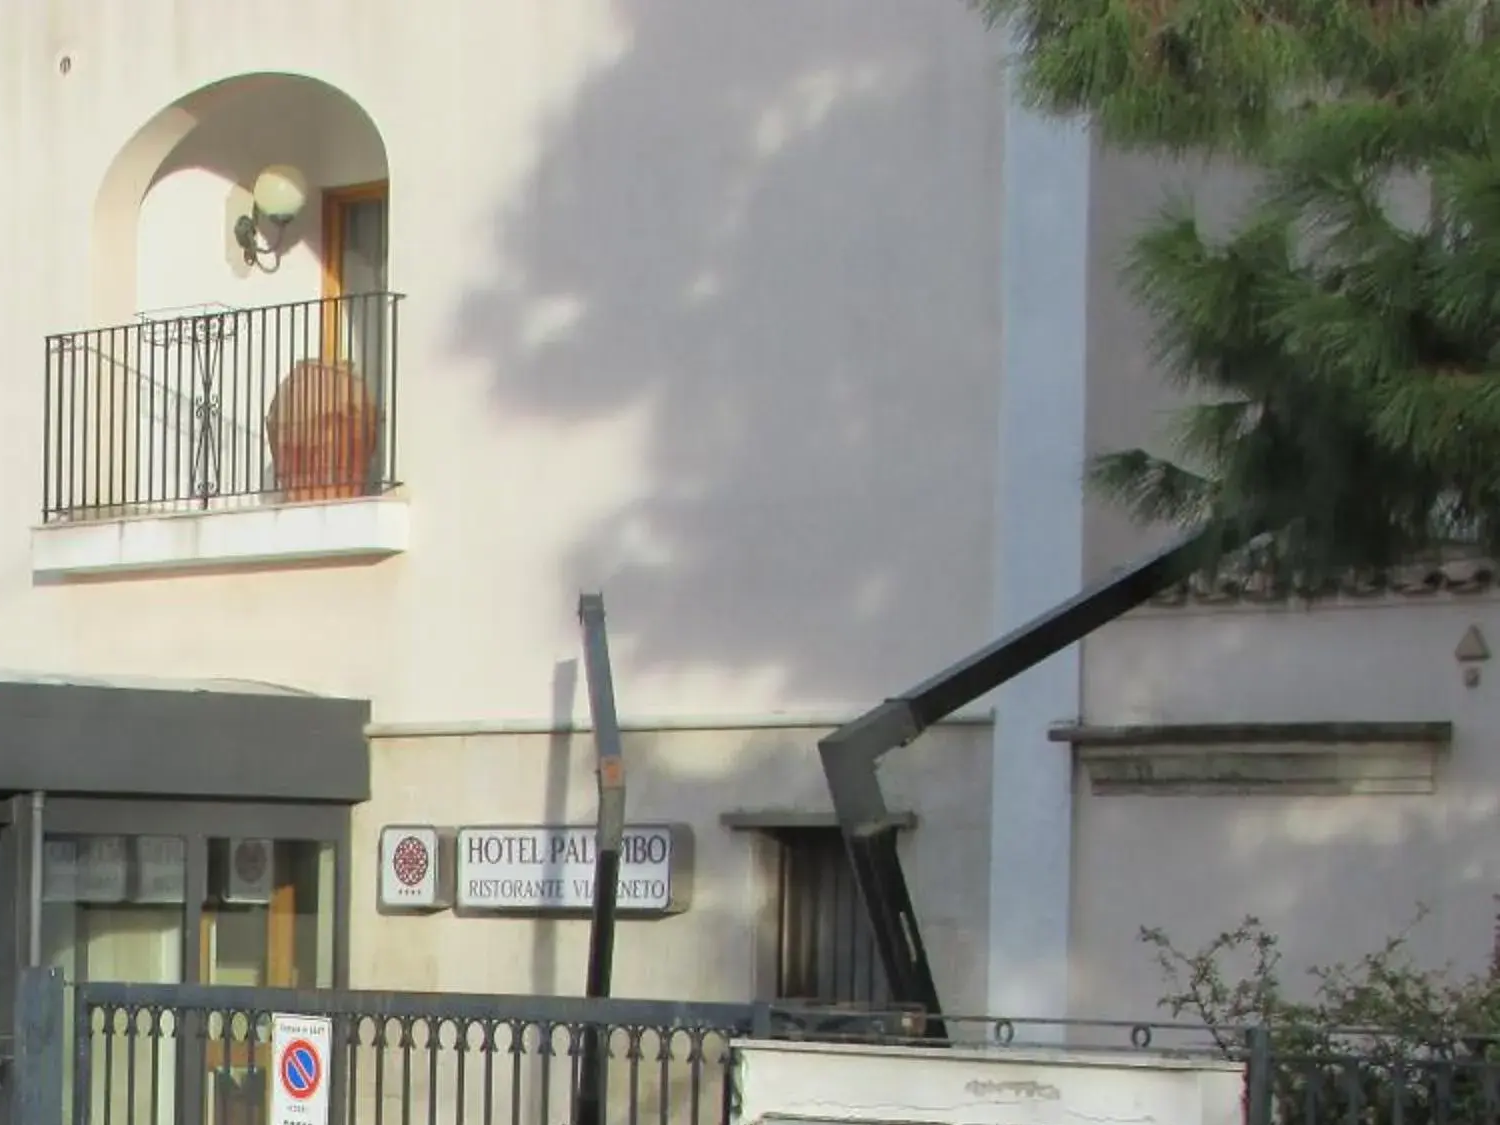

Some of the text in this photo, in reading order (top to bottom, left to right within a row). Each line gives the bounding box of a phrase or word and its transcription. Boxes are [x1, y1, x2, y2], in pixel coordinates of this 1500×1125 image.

[468, 834, 667, 865] HOTEL PALBO
[469, 879, 564, 898] RISTORANTE
